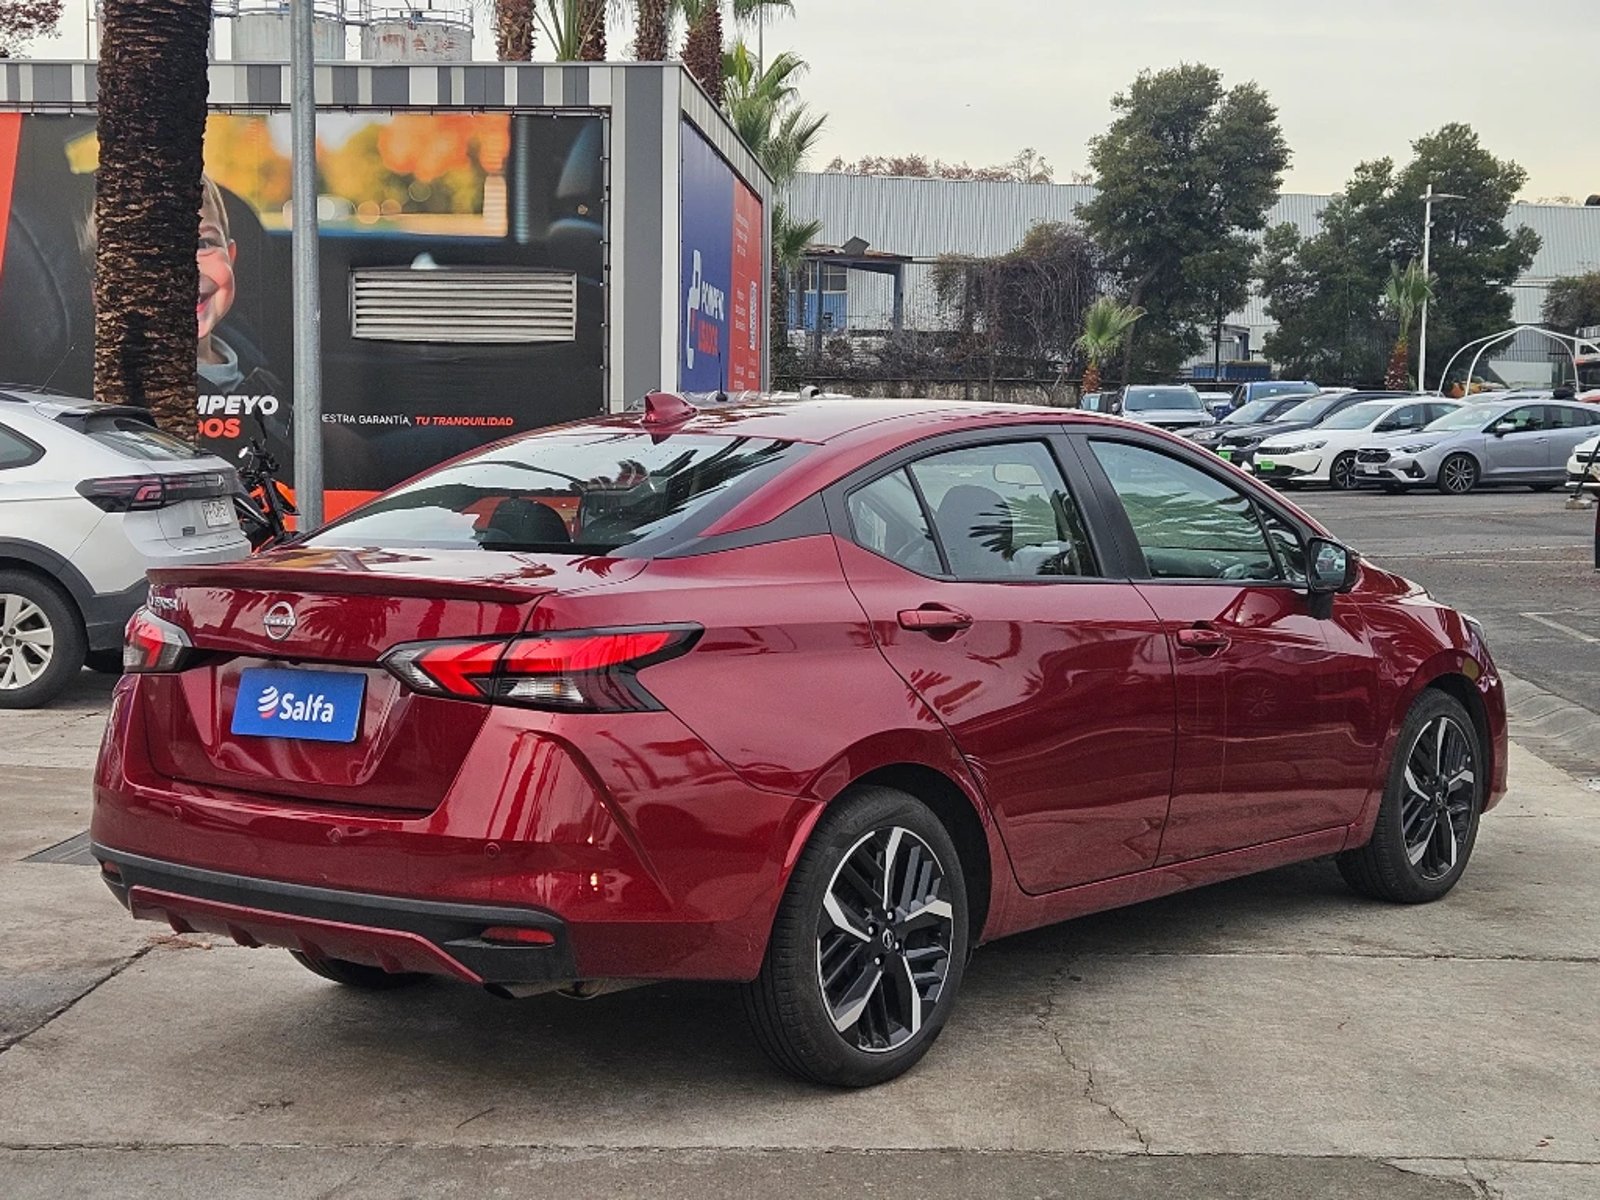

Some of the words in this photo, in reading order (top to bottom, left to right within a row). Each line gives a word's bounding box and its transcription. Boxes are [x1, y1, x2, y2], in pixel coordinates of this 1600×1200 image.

[197, 418, 241, 438] OS
[358, 413, 411, 427] GARANTÍA,
[415, 416, 430, 426] TU
[432, 416, 514, 427] TRANQUILIDAD
[279, 692, 335, 723] Salfa
